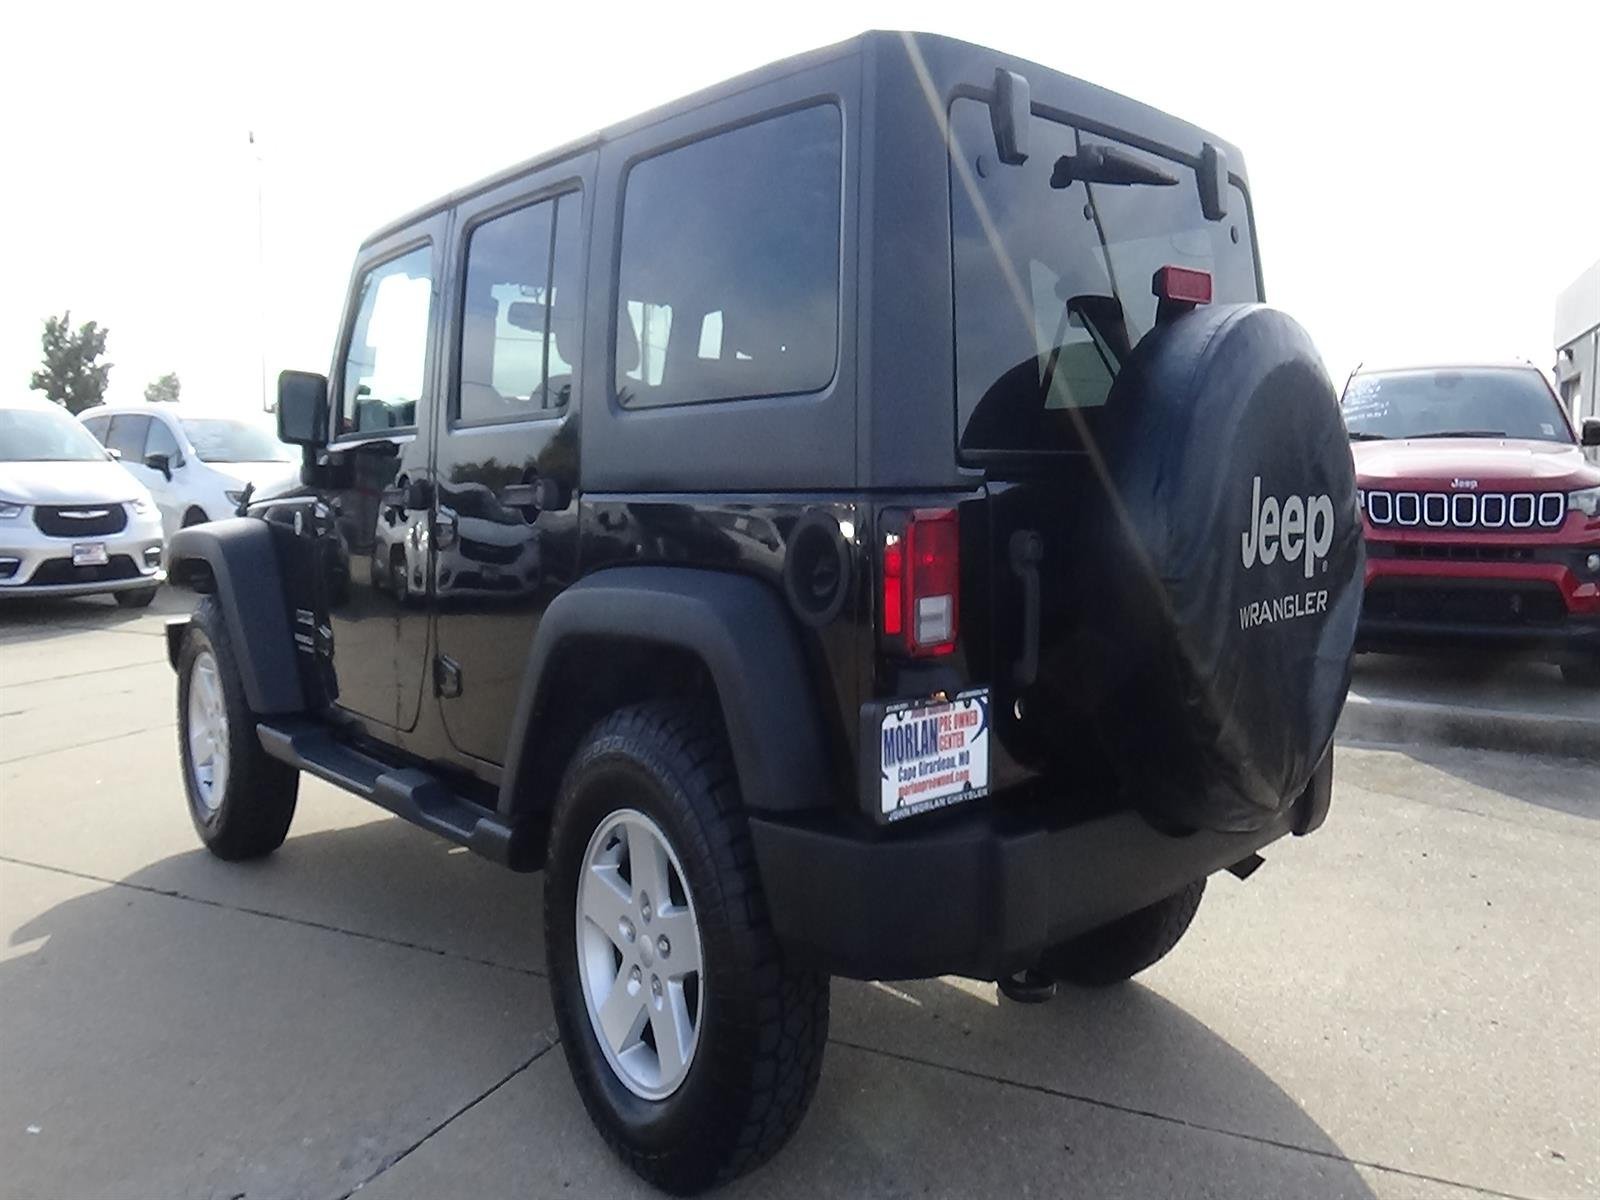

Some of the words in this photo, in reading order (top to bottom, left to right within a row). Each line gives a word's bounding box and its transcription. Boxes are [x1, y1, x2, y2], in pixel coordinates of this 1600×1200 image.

[1450, 478, 1478, 489] Jeep
[1242, 476, 1334, 578] Jeep
[1240, 590, 1328, 630] WRANGLER
[883, 717, 938, 768] MORLAN
[939, 731, 964, 751] CENTER
[898, 766, 916, 782] Cape
